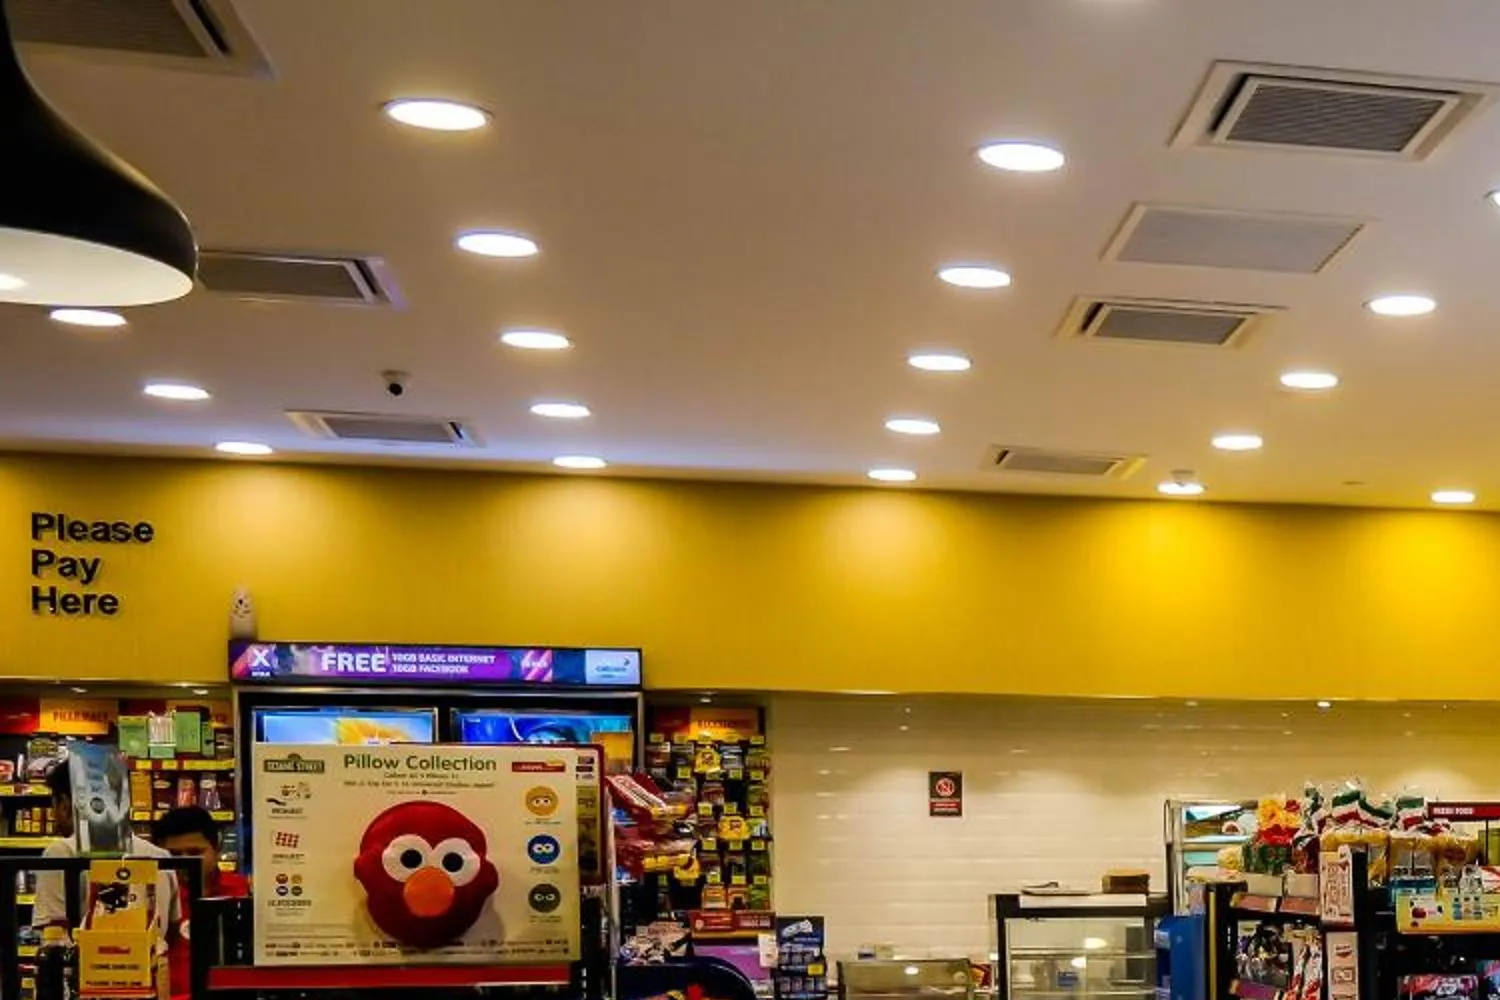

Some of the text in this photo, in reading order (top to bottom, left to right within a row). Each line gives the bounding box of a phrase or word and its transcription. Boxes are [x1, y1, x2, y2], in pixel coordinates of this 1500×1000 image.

[31, 511, 154, 543] Please
[31, 548, 101, 585] Pay
[31, 585, 119, 616] Here
[320, 651, 387, 673] FREE
[344, 753, 399, 769] Pillow
[405, 755, 497, 771] Collection
